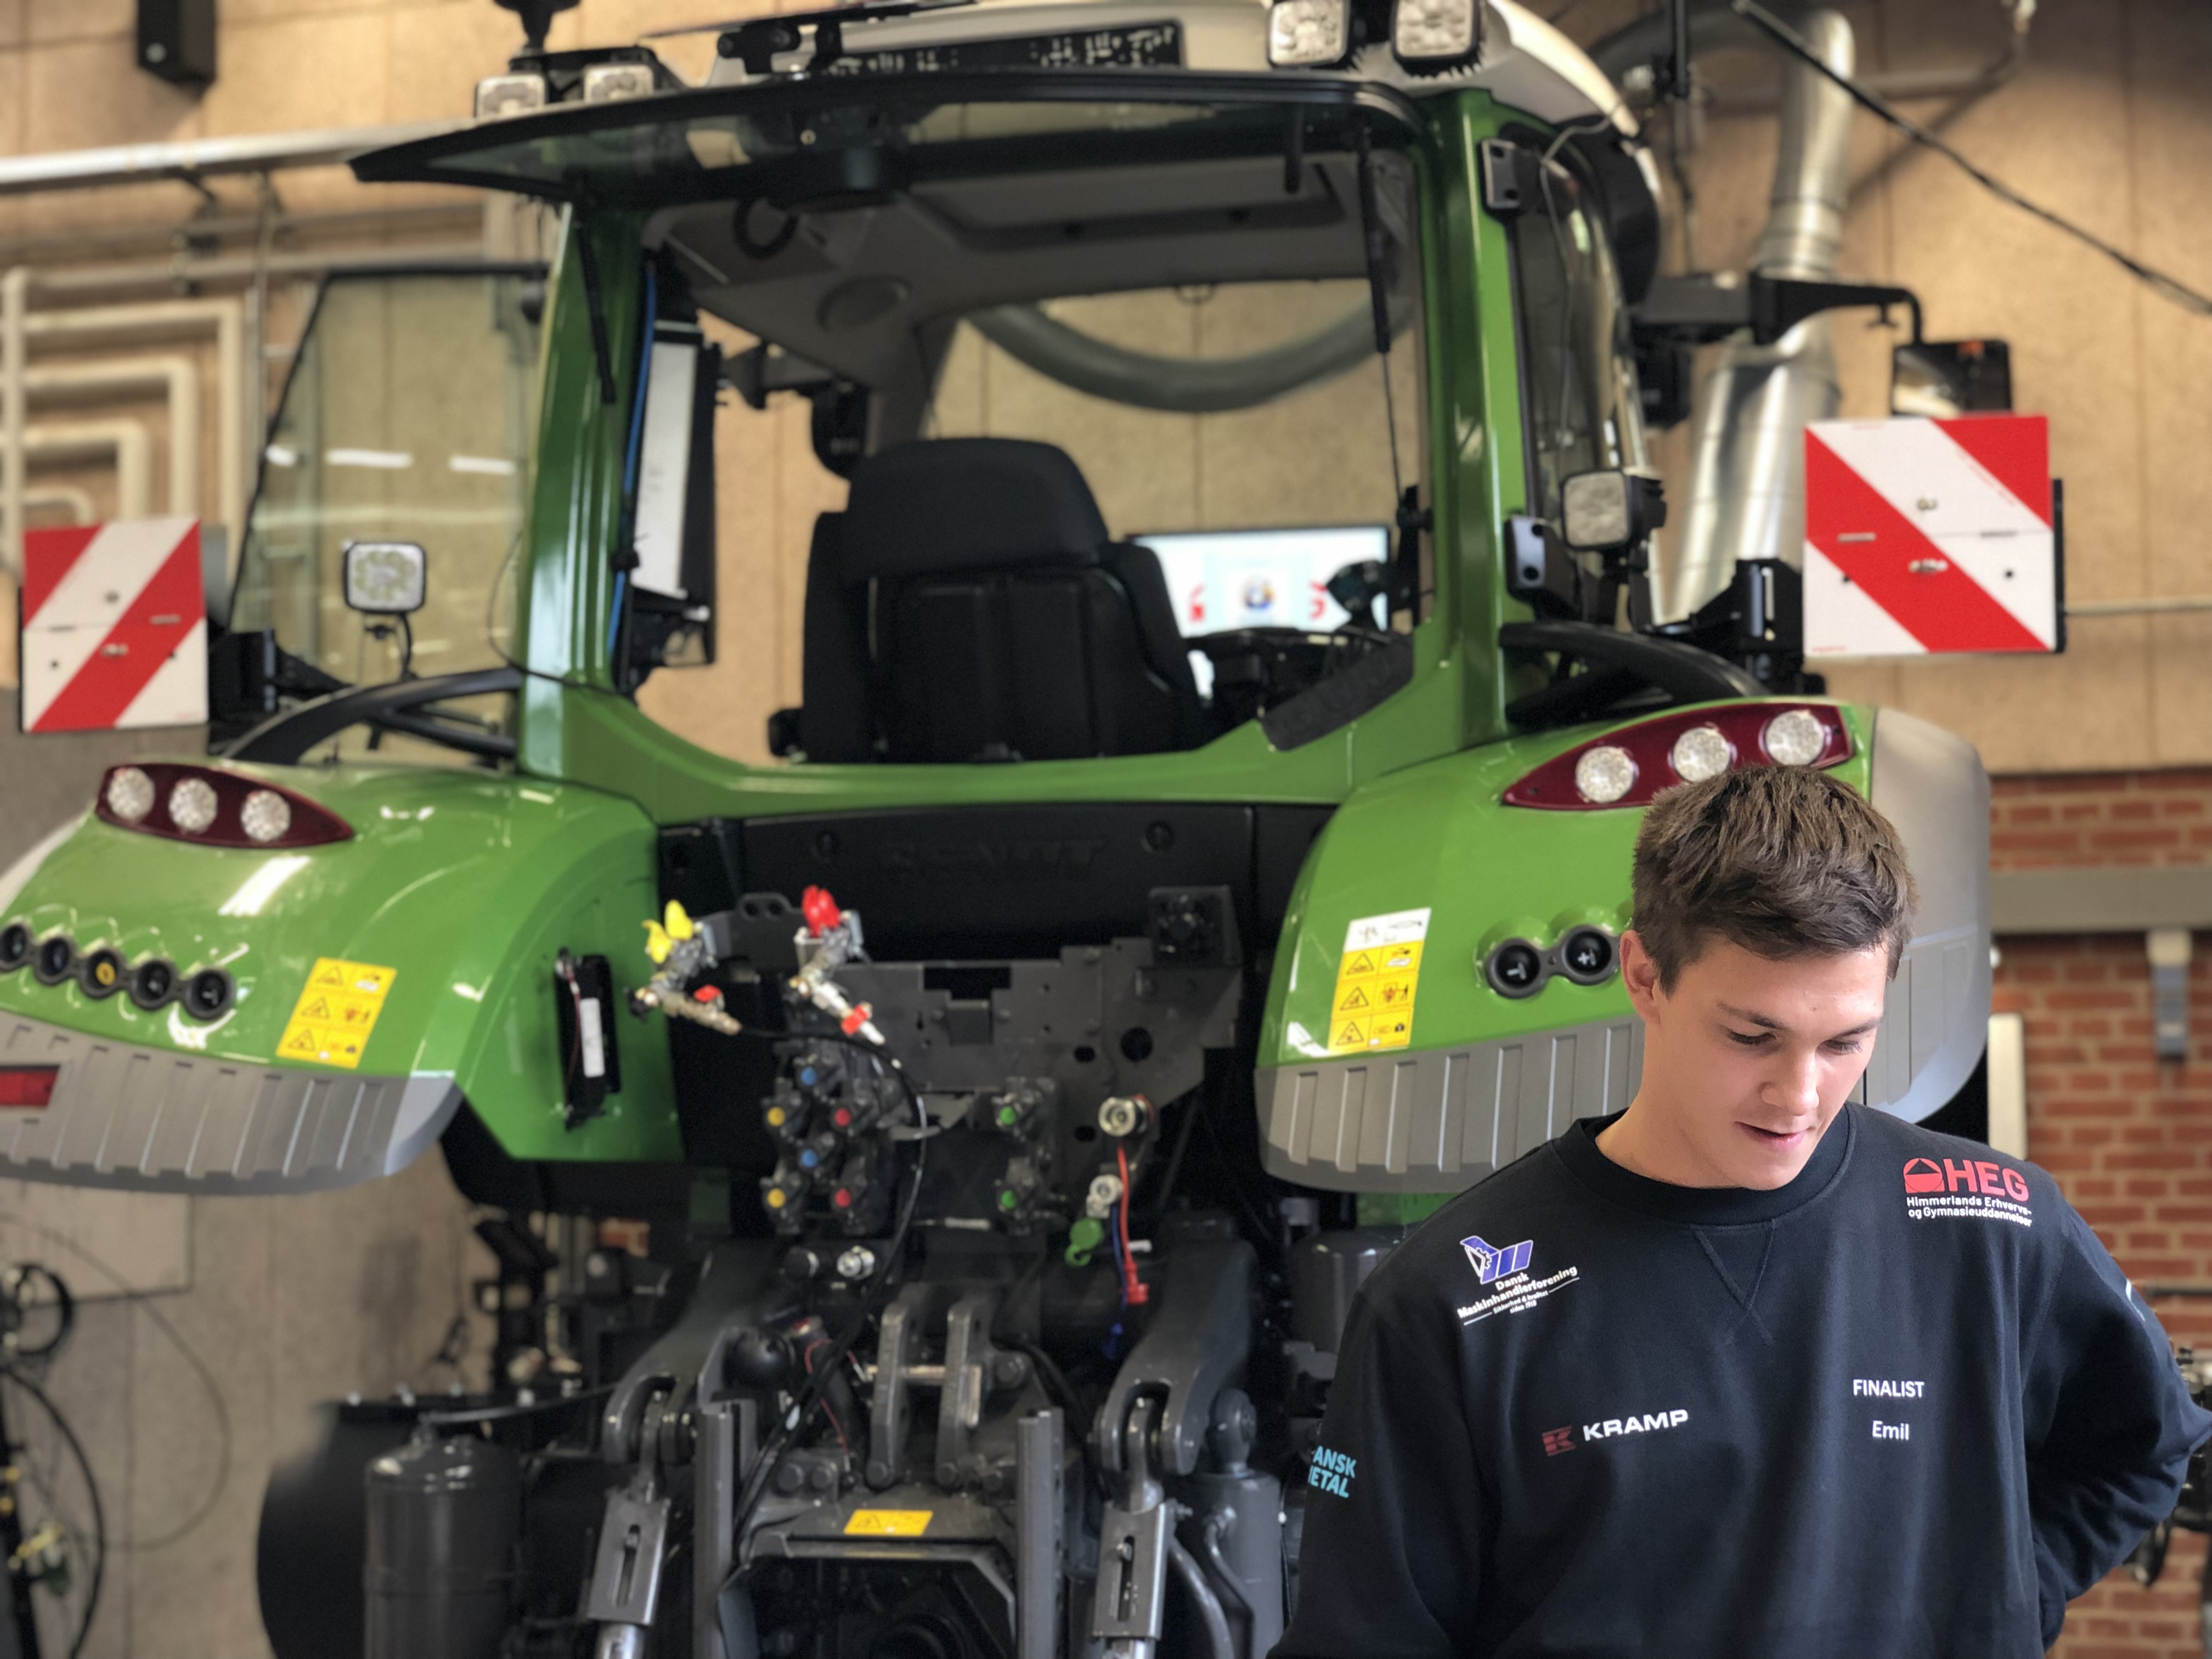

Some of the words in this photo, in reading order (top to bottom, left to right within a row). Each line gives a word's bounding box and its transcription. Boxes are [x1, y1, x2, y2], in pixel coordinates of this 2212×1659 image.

[1943, 1158, 2029, 1202] HEG
[1906, 1195, 1982, 1207] Himmerlands
[1984, 1197, 2033, 1216] Erhvervs-
[1908, 1209, 1922, 1220] og
[1923, 1206, 2033, 1227] Gymnasieuddannelser
[1457, 1266, 1578, 1318] Maskinhandlerforening
[1495, 1272, 1529, 1291] Dansk
[1853, 1379, 1925, 1398] FINALIST
[1583, 1409, 1689, 1442] KRAMP
[1872, 1420, 1910, 1441] Emil
[1307, 1465, 1350, 1498] ETAL
